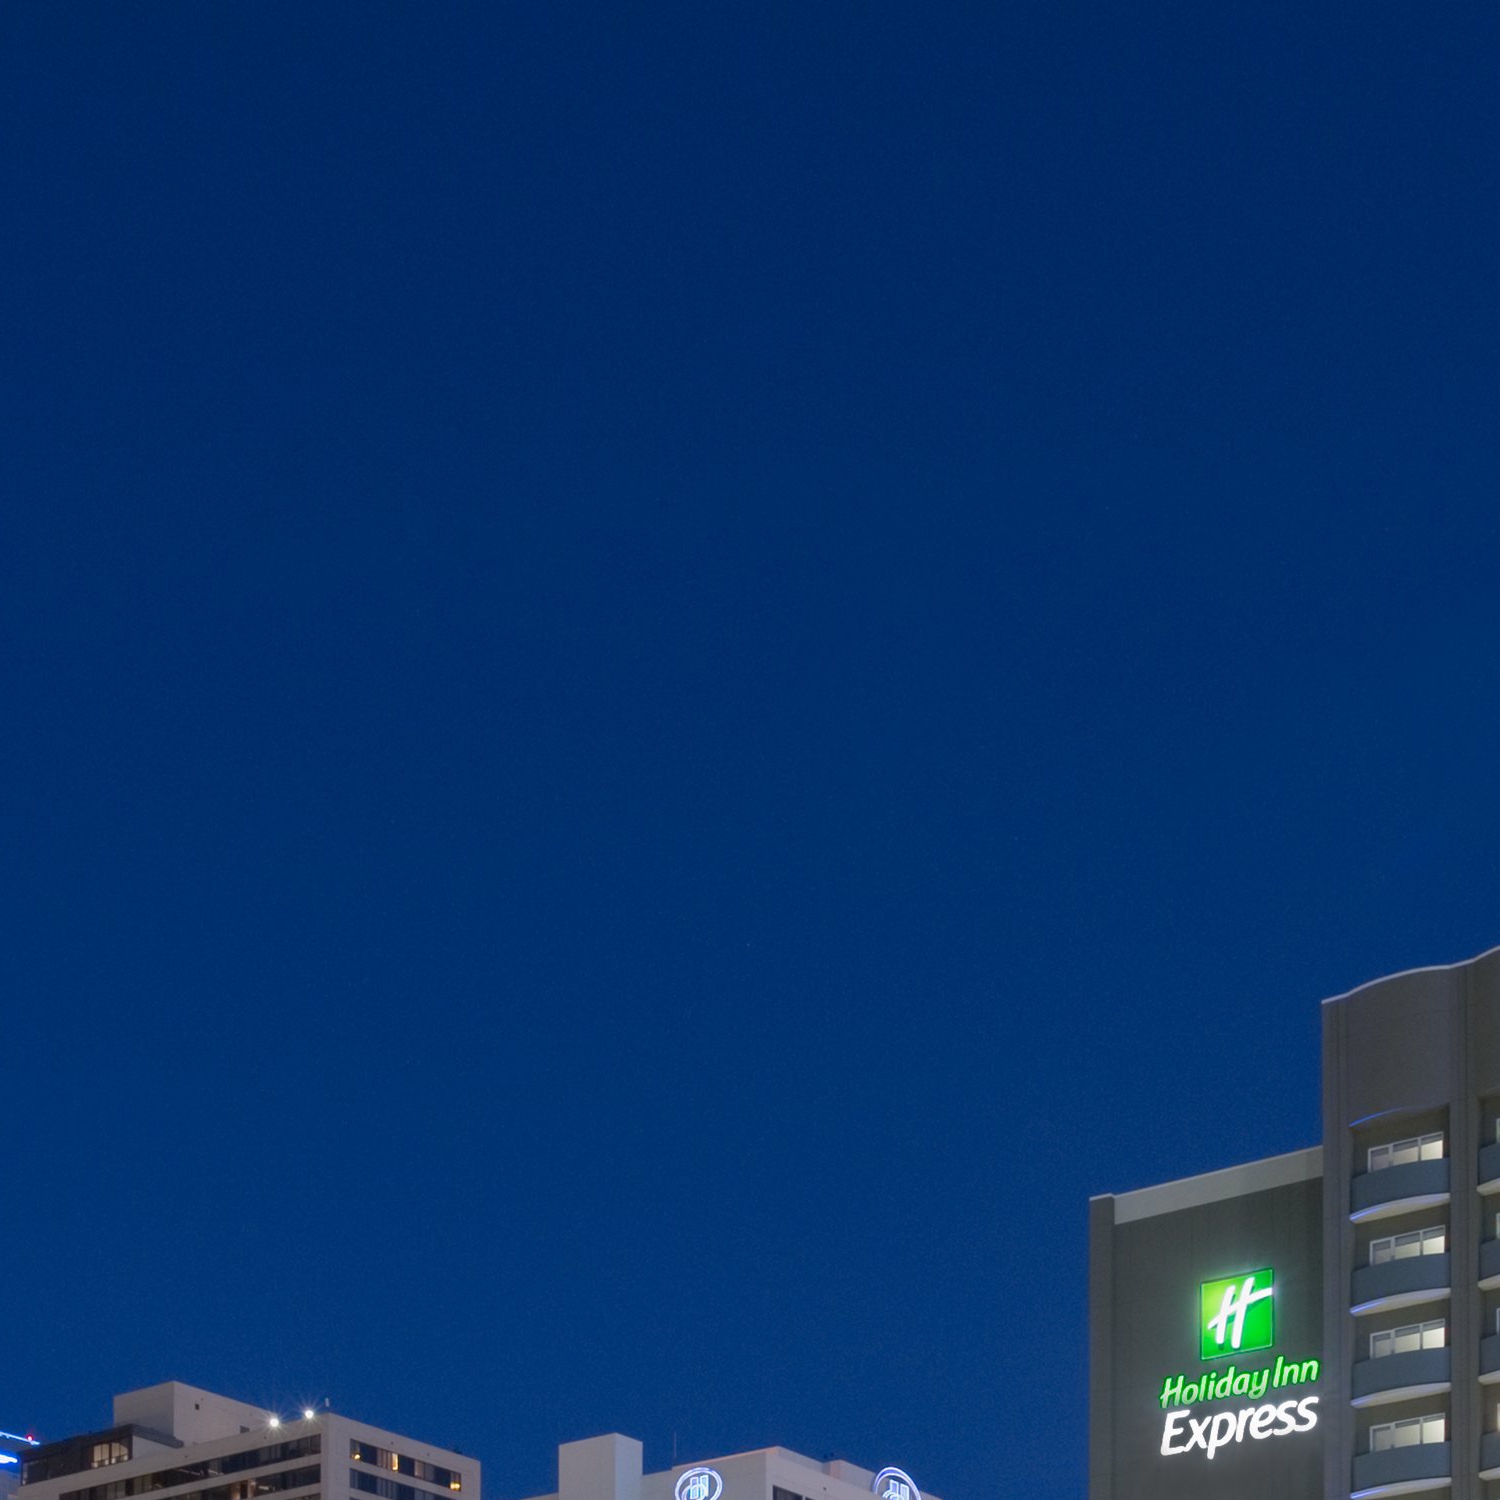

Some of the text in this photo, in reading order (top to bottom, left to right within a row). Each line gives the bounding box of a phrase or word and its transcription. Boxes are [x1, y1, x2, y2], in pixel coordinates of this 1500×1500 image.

[1160, 1356, 1320, 1409] Holiday Inn
[1160, 1396, 1320, 1460] Express
